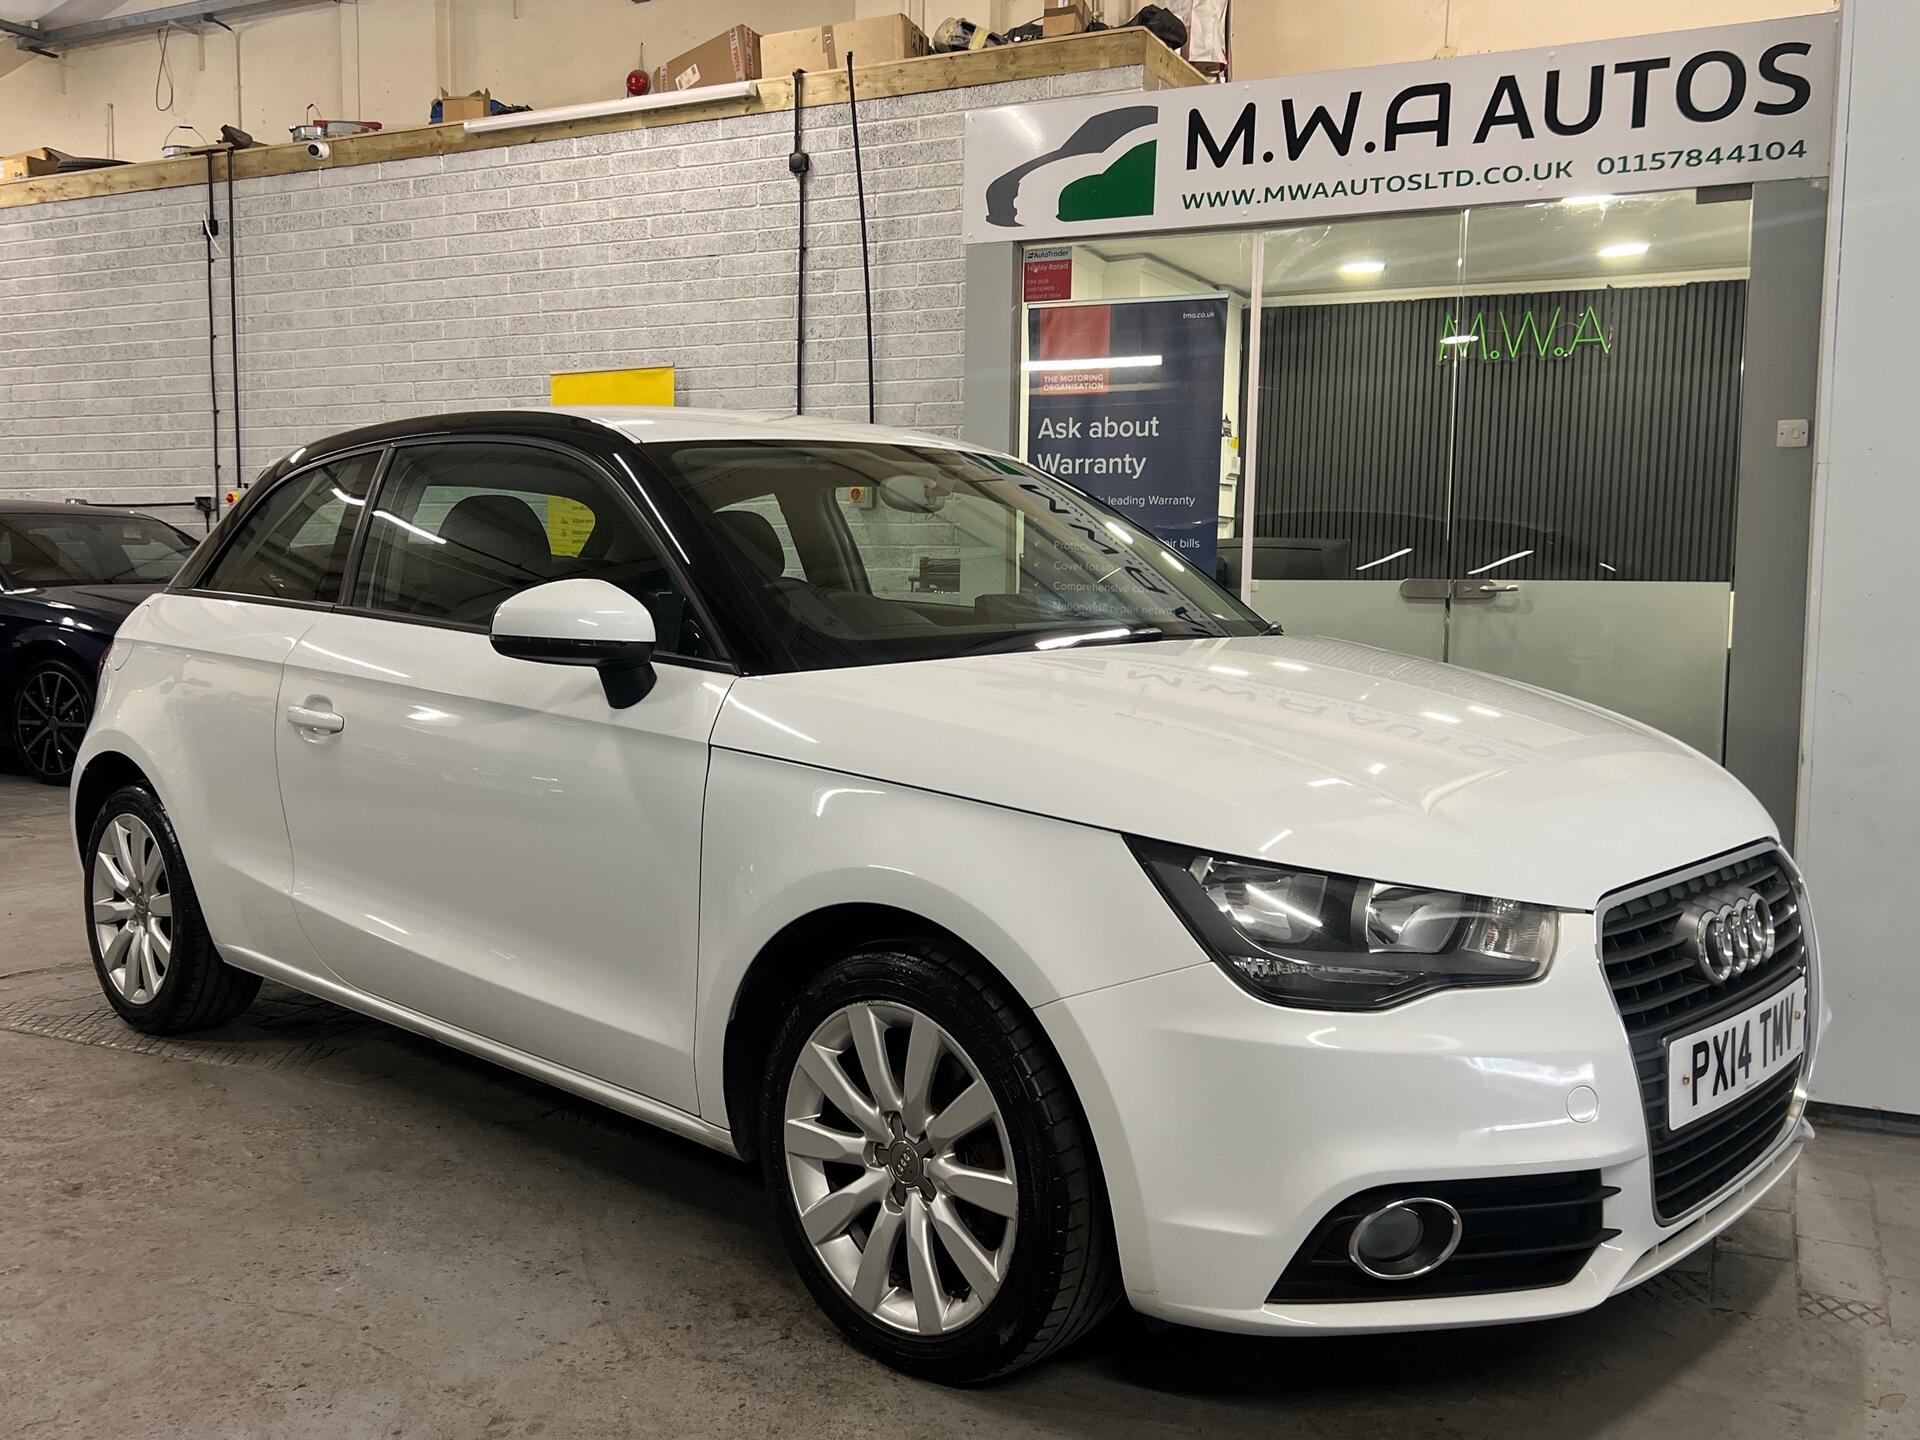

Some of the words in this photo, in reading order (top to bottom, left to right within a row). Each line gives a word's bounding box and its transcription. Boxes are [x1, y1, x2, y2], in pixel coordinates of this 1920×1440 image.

[1186, 82, 1451, 170] M.W.A
[1472, 41, 1813, 144] AUTOS
[1182, 160, 1573, 209] WWW.MWAAUTOSLTD.CO.UK
[1597, 139, 1808, 175] 01157844104
[1033, 249, 1069, 259] AutoTrader
[1049, 262, 1069, 271] Rated
[1183, 311, 1215, 319] tmo.co.uk
[1438, 305, 1609, 361] M.W.A
[1043, 375, 1058, 383] THE
[1059, 374, 1104, 383] MOTORING
[1043, 382, 1104, 392] ORGANISATION
[1037, 417, 1082, 439] Ask
[1089, 416, 1159, 438] about
[1037, 453, 1147, 479] Warranty
[1108, 496, 1145, 507] leading
[1148, 496, 1195, 507] Warranty
[1180, 538, 1200, 548] bills
[1053, 582, 1129, 594] Comprehensive
[1692, 1018, 1752, 1107] PX14
[1760, 992, 1796, 1069] TMV
